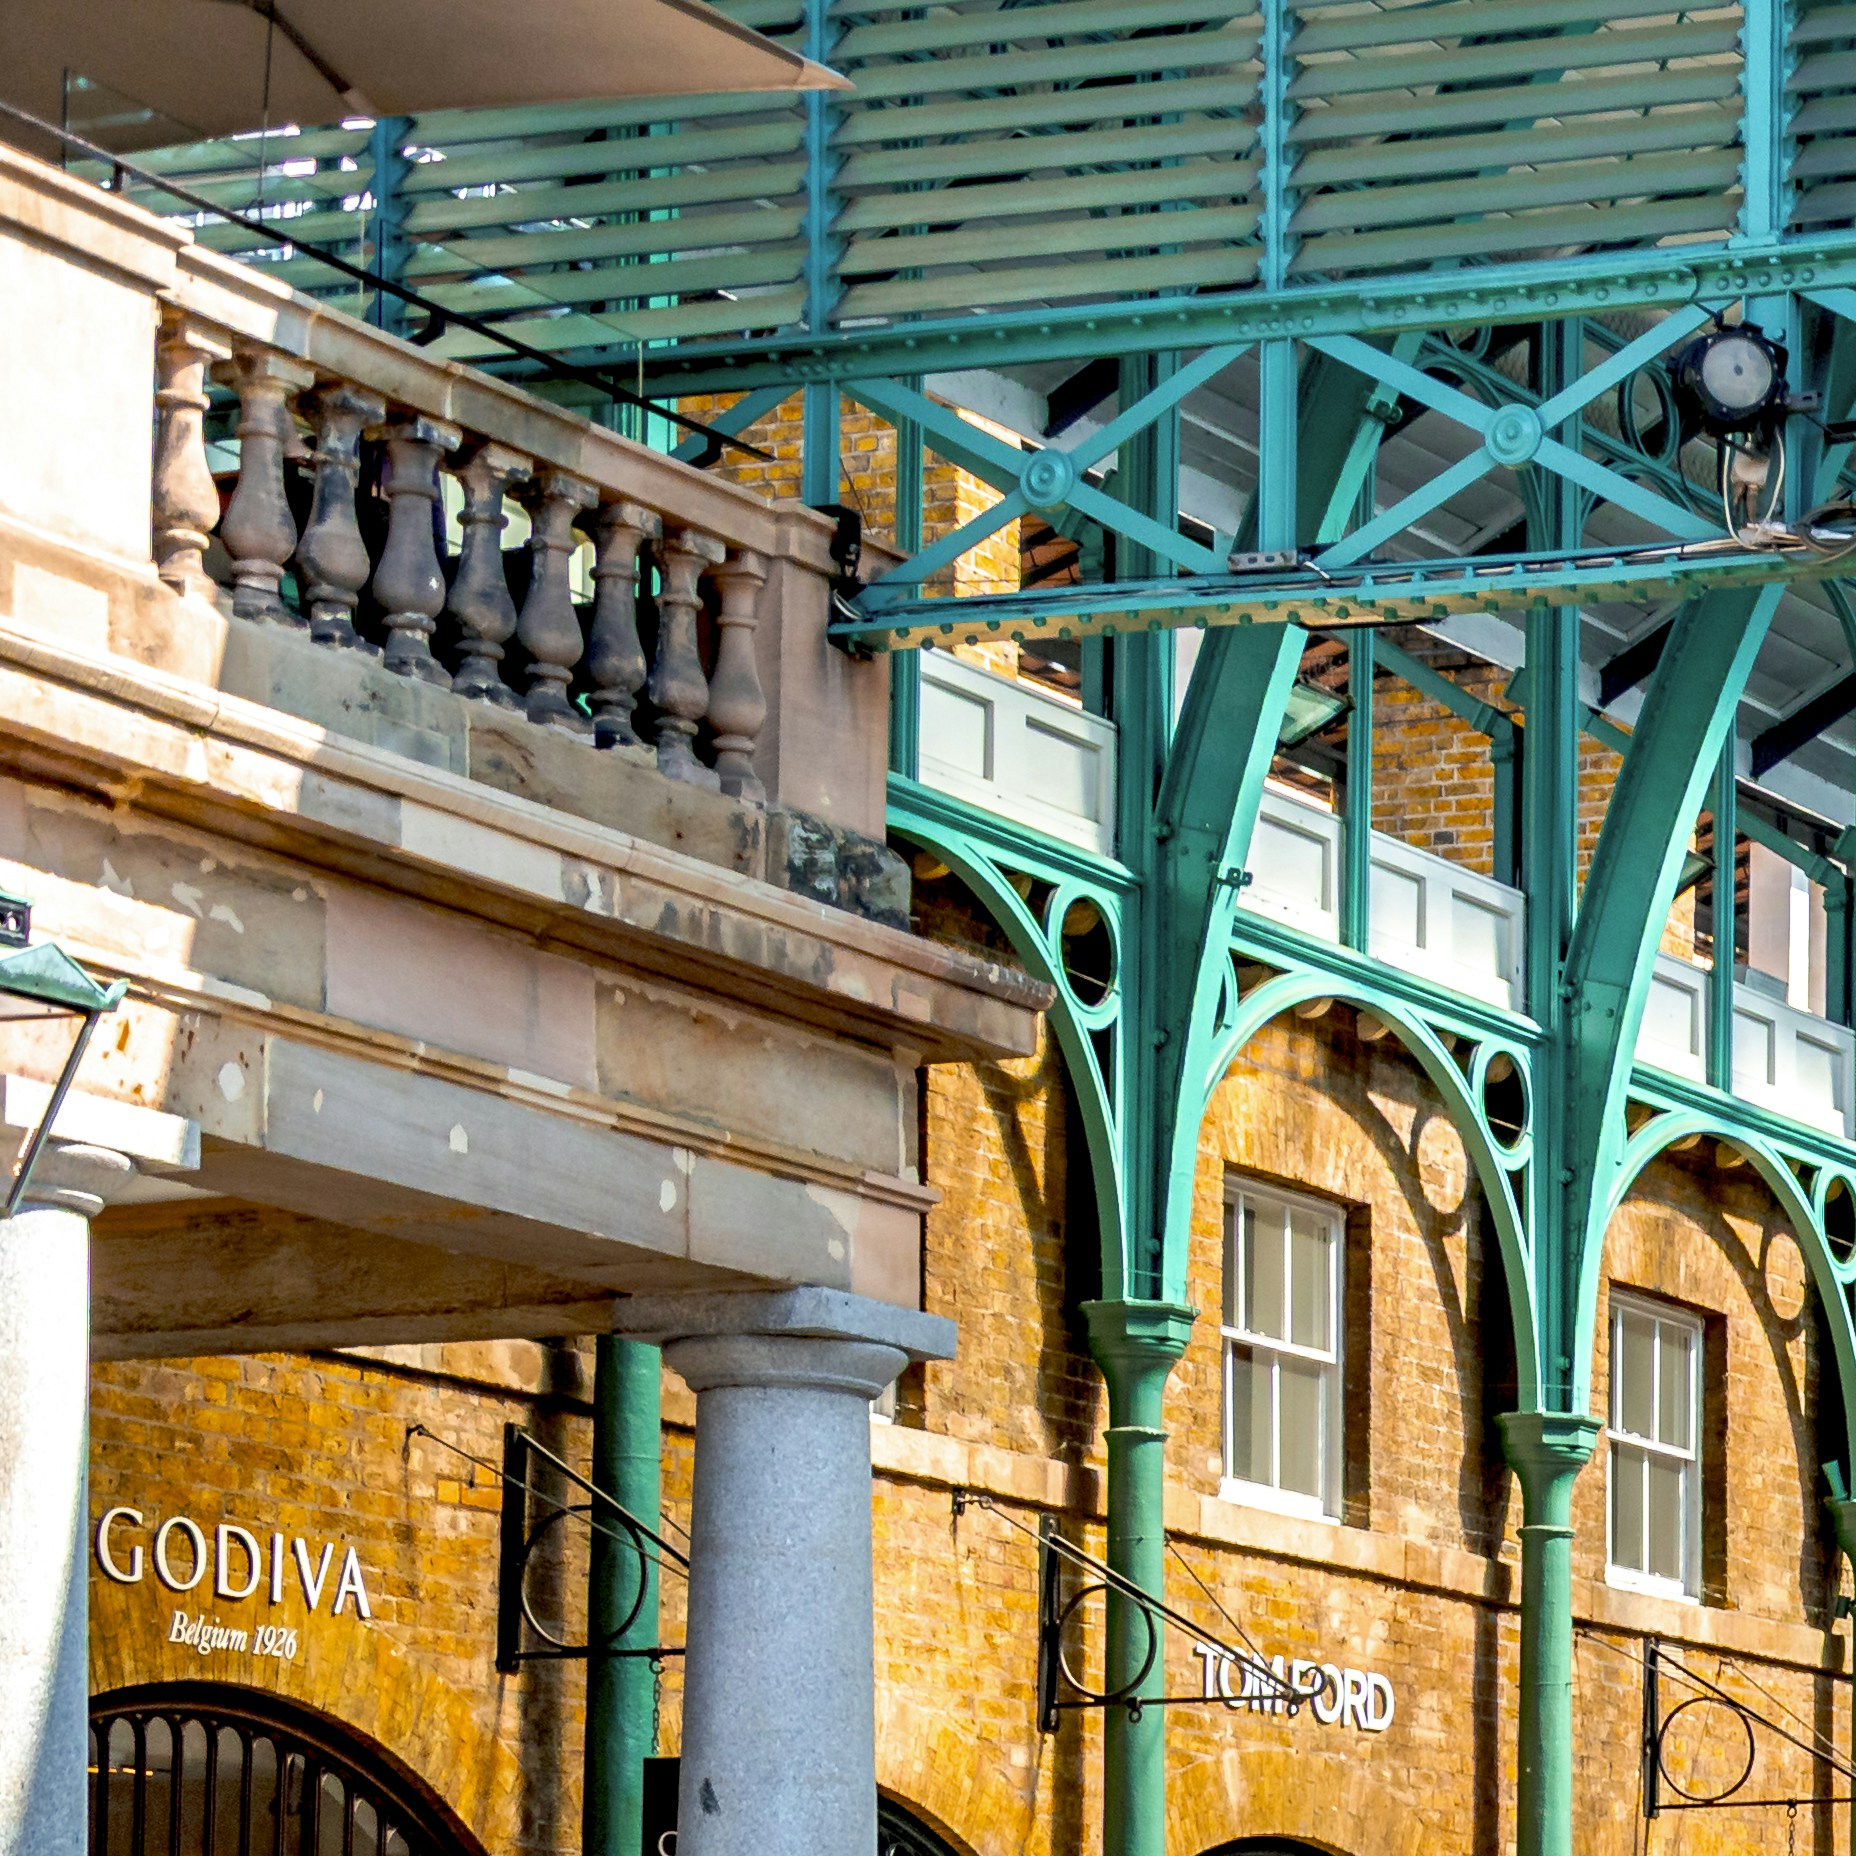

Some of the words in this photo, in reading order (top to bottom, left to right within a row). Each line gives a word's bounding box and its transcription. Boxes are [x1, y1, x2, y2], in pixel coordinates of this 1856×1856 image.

[95, 1506, 372, 1619] GODIVA
[169, 1610, 247, 1656] Belgium
[251, 1625, 297, 1660] 1926
[1194, 1640, 1285, 1714] TOM
[1290, 1658, 1395, 1731] FORD
